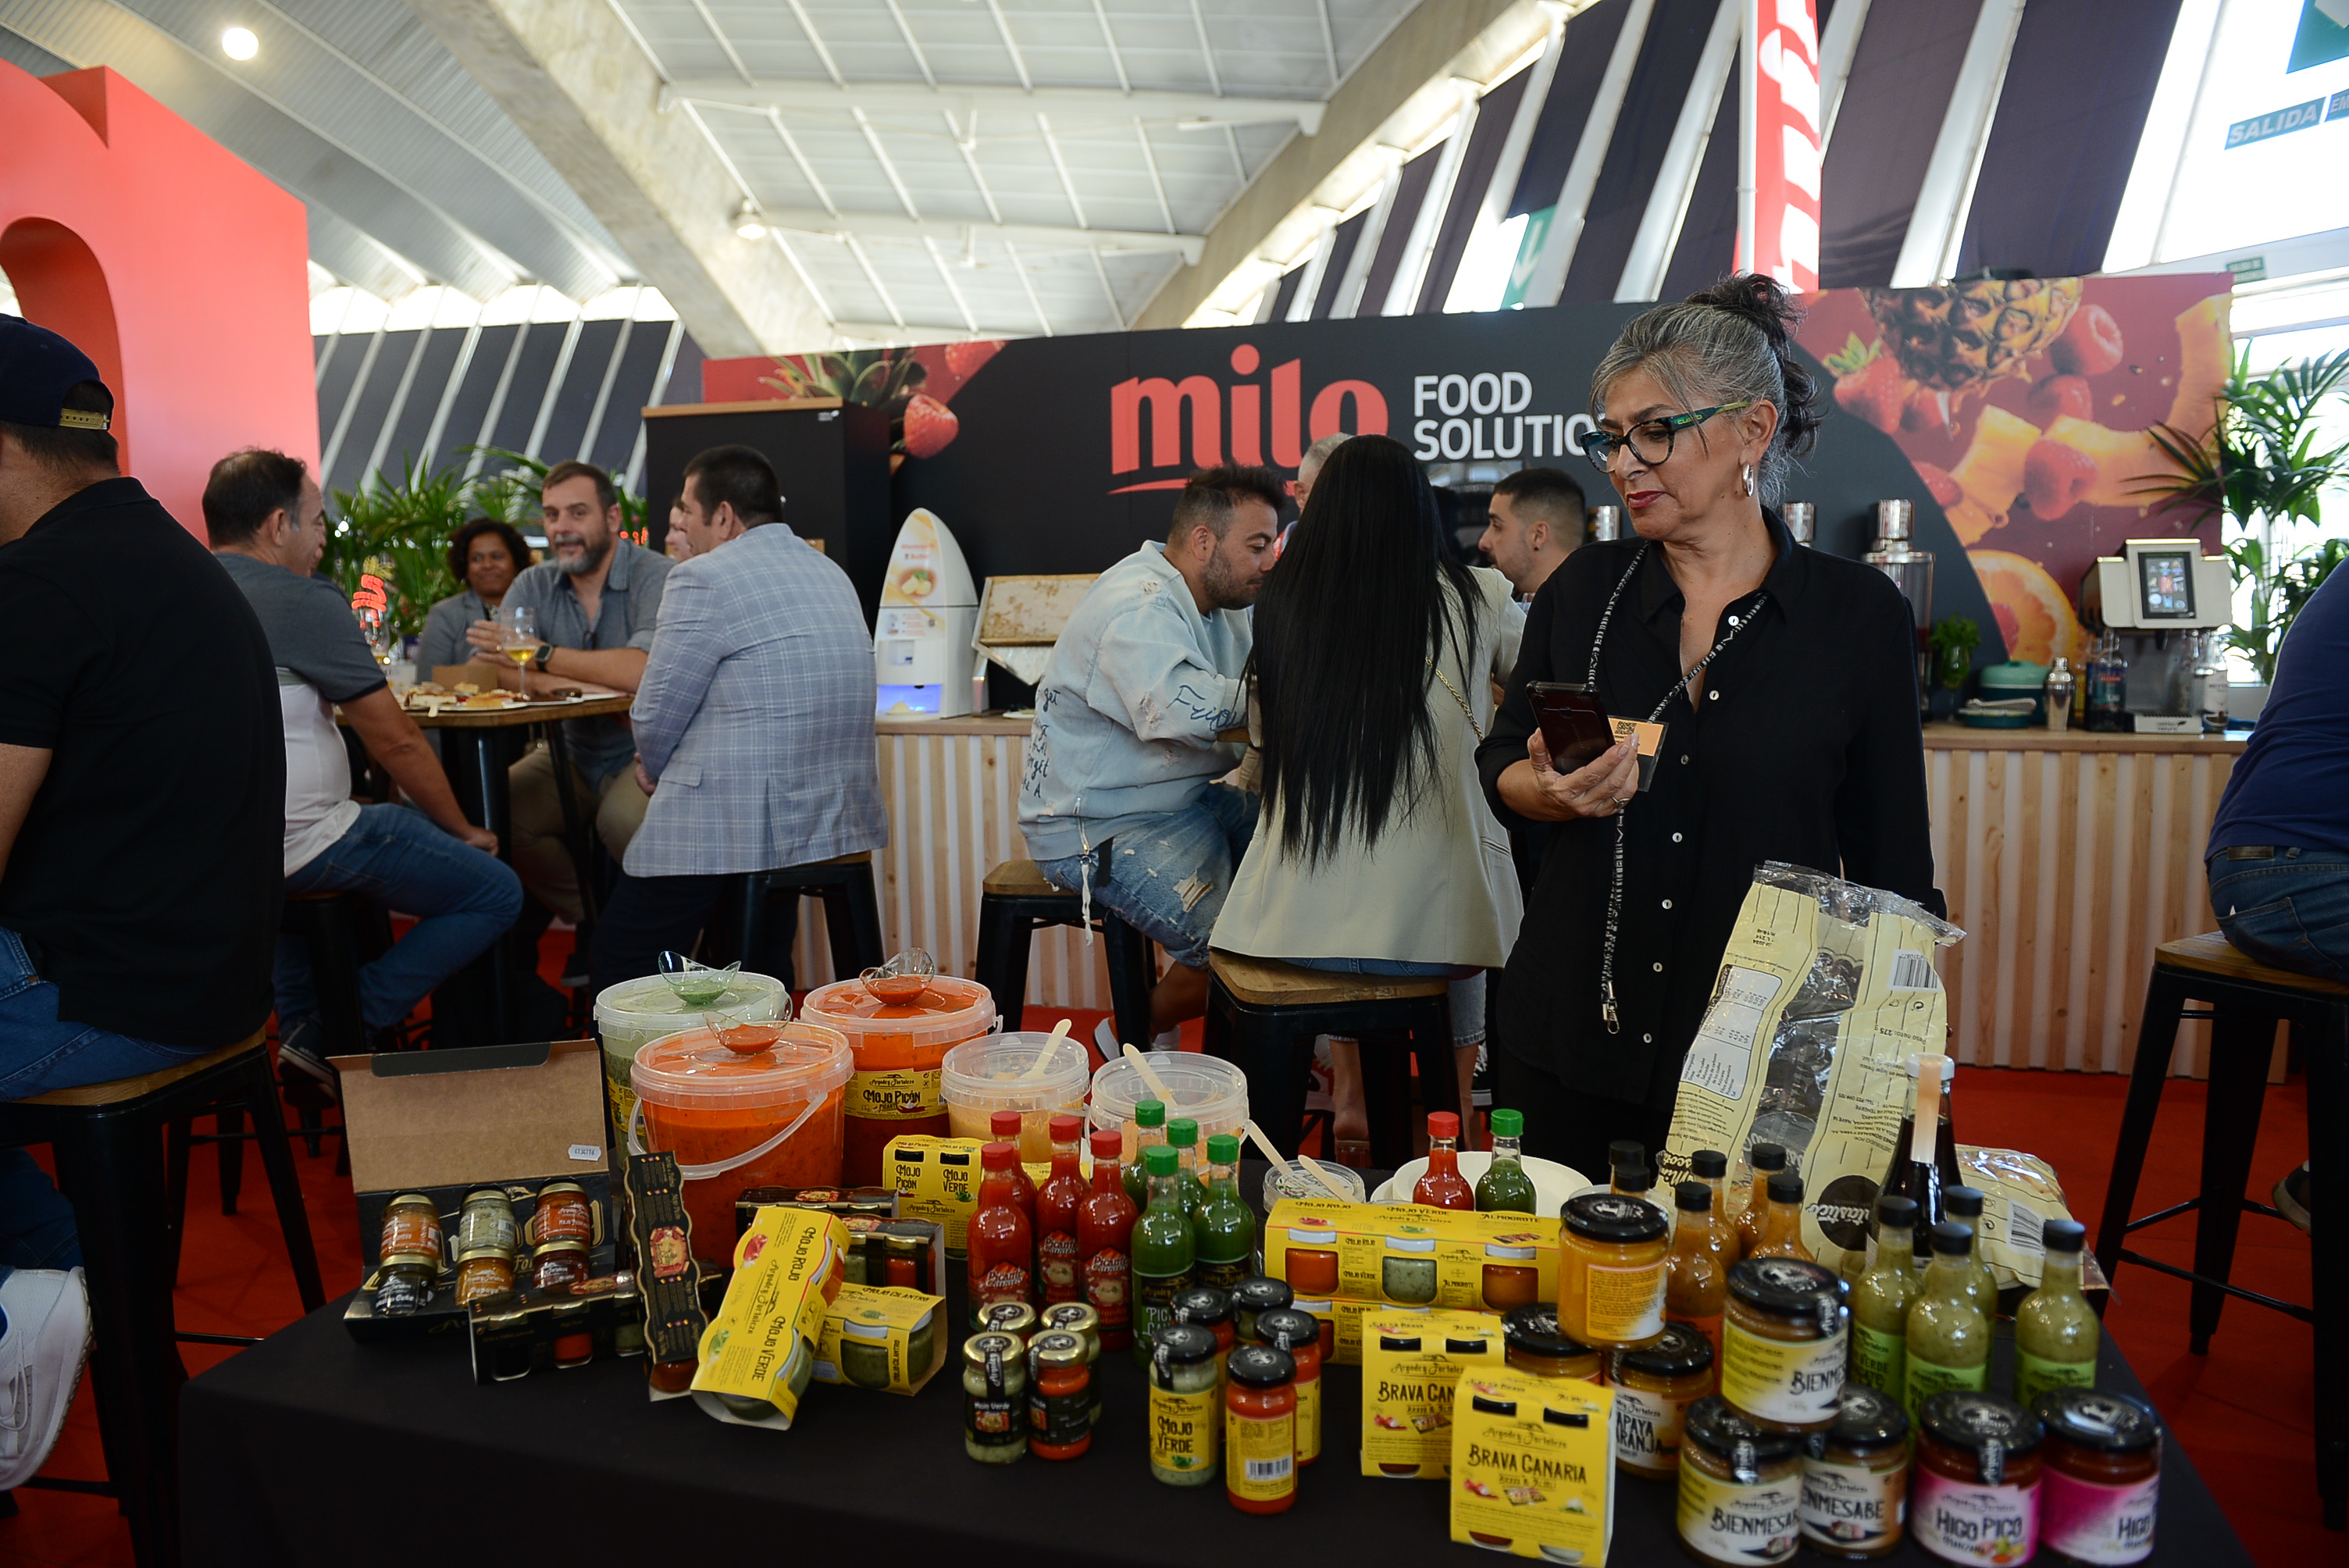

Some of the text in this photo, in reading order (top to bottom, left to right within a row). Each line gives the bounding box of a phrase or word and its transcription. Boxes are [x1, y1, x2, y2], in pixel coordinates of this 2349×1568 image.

[2230, 92, 2349, 145] SALIDA EM
[1414, 372, 1532, 417] FOOD
[1111, 344, 1388, 474] milo
[1413, 413, 1595, 461] SOLUTIO
[1879, 1027, 1894, 1036] 275
[1894, 1030, 1912, 1040] neto:
[1911, 1035, 1927, 1045] Peso
[863, 1089, 920, 1103] MOJO PICÓN
[1855, 1105, 1876, 1114] TENERIFE
[896, 1164, 921, 1177] MOJO
[943, 1169, 968, 1181] MOJO
[896, 1177, 917, 1189] PICÓN
[943, 1179, 968, 1193] VERDE
[1481, 1213, 1541, 1223] ALMOGROTE
[1044, 1236, 1078, 1253] Picante
[788, 1226, 817, 1281] MOJO ROJO
[1093, 1254, 1129, 1268] Picante
[986, 1269, 1024, 1282] Picante
[889, 1291, 930, 1302] CILANTRO
[1146, 1306, 1171, 1322] PIC
[751, 1316, 786, 1382] MOJO VERDE
[1428, 1363, 1464, 1374] Fortalez
[1378, 1381, 1455, 1402] BRAVA CAN
[1157, 1416, 1192, 1435] MOJO
[1616, 1411, 1654, 1437] APAYA
[1157, 1434, 1193, 1453] VERDE
[1616, 1427, 1663, 1454] RANJA
[1467, 1443, 1517, 1471] BRAVA
[1520, 1453, 1587, 1485] CANARIA
[1936, 1508, 2023, 1541] HIGO PICO
